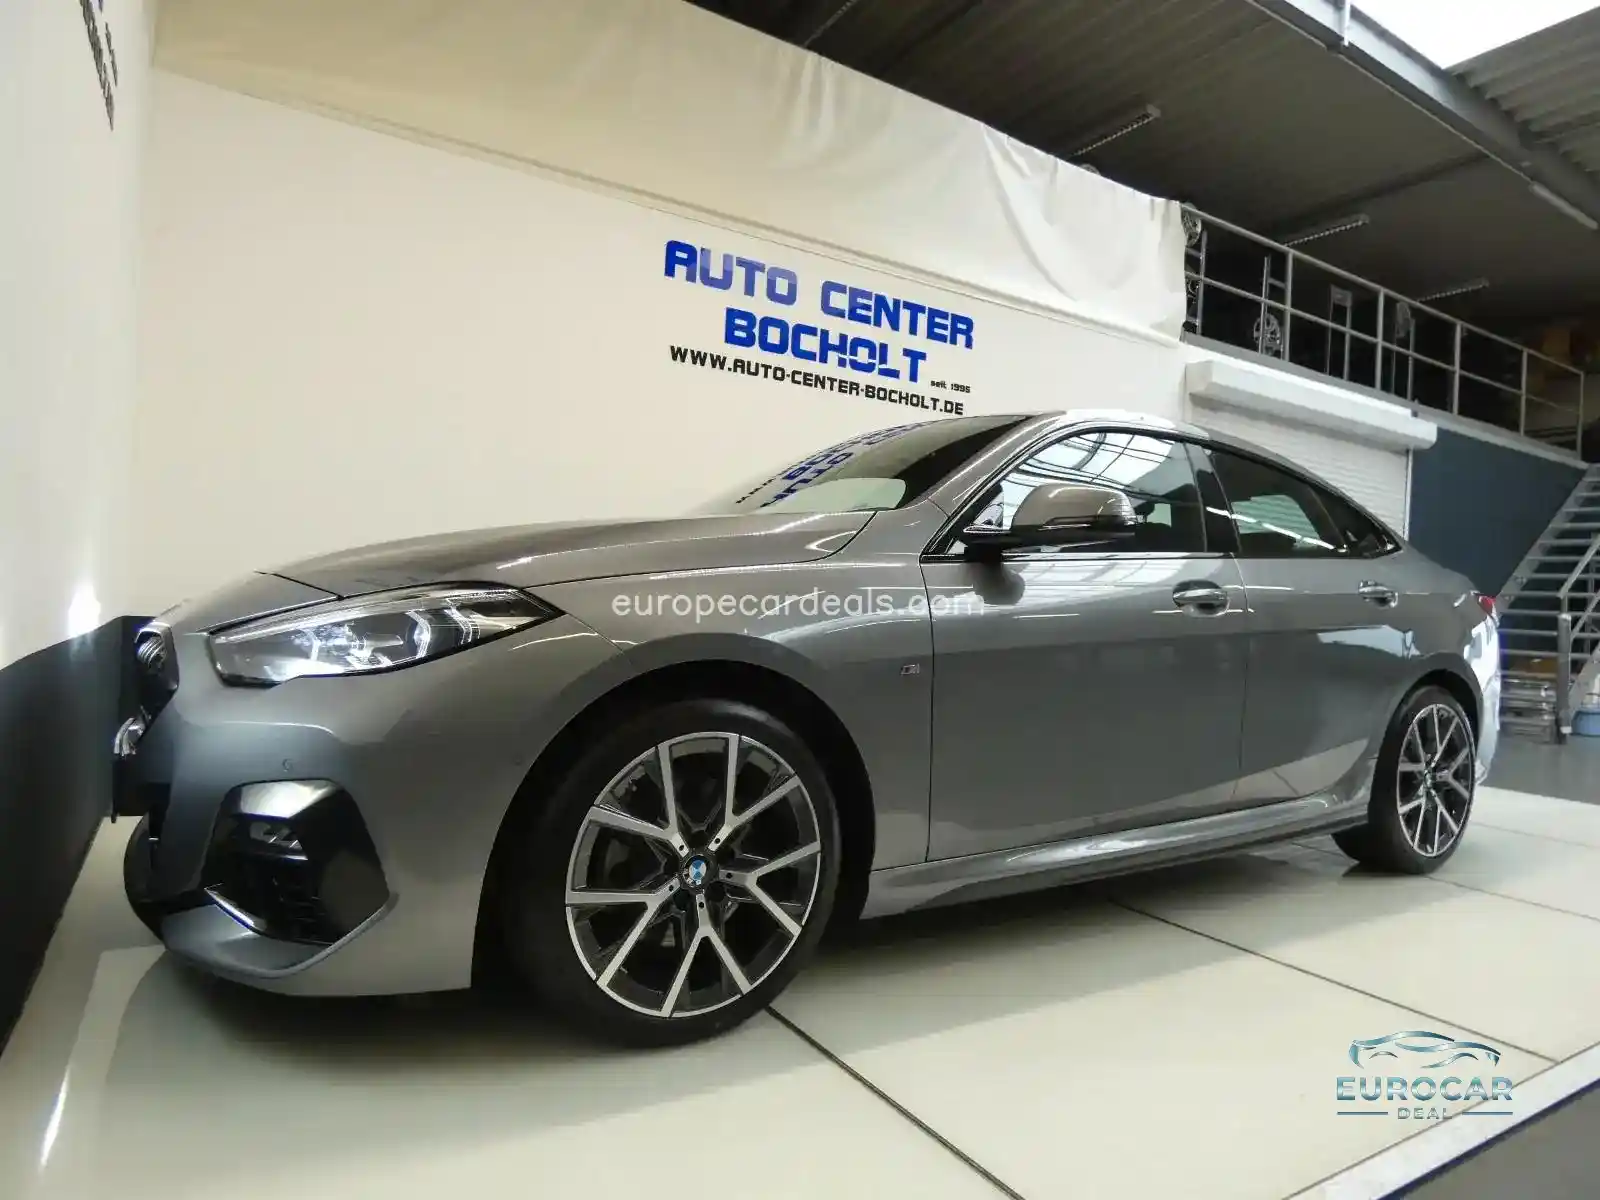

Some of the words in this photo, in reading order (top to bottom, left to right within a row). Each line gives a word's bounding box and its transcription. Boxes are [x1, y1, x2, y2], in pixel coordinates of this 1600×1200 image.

[664, 240, 797, 306] AUTO
[820, 280, 974, 349] CENTER
[669, 345, 964, 415] WWW.AUTO-CENTER-BOCHOLT.DE
[724, 306, 926, 383] BOCHOLT
[930, 380, 947, 389] seit
[950, 383, 971, 393] 1995
